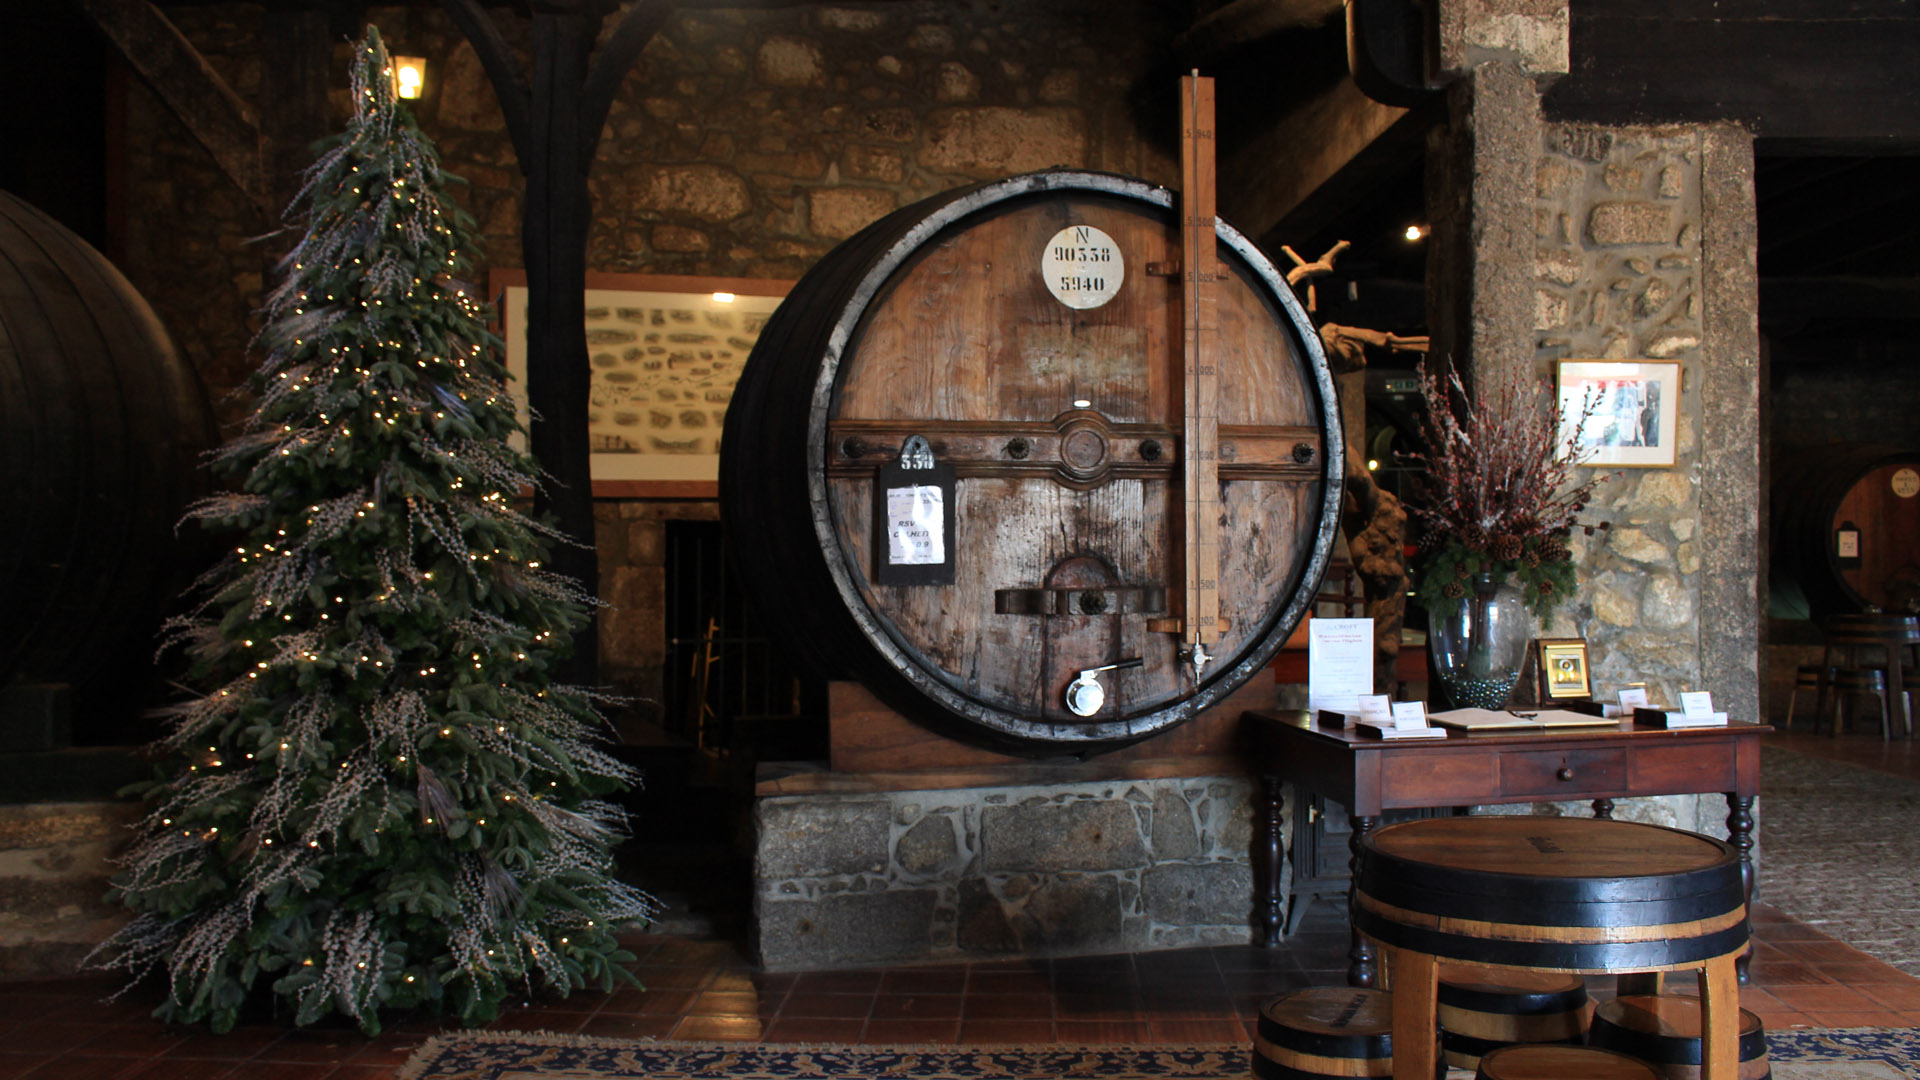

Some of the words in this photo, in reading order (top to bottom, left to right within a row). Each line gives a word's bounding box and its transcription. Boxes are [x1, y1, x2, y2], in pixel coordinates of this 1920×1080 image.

[1076, 226, 1089, 244] N
[1055, 247, 1110, 262] 90338
[1061, 276, 1105, 291] 5940
